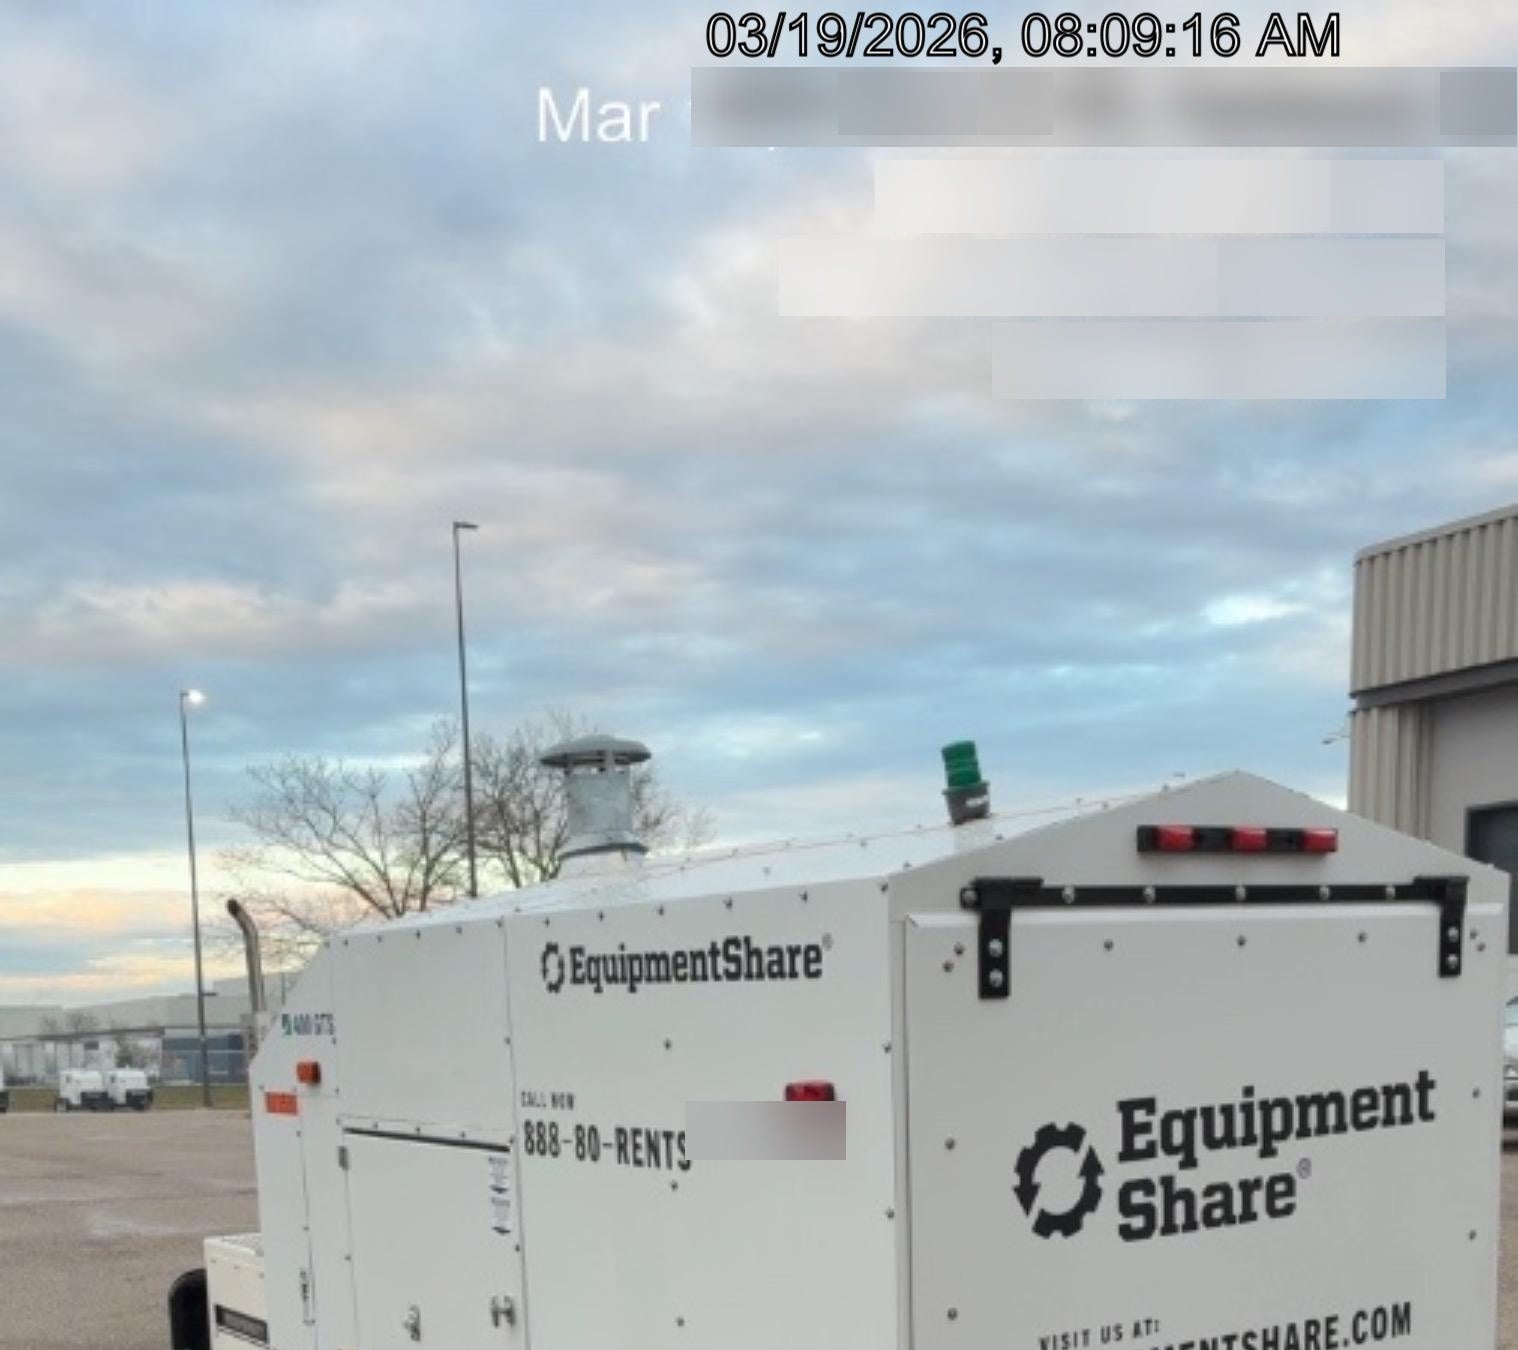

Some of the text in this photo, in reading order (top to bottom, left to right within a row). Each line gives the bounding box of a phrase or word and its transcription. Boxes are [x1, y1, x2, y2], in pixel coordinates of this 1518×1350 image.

[521, 1091, 547, 1108] CALL
[1117, 1070, 1437, 1170] Equipment
[1117, 1171, 1297, 1243] Share
[1100, 1323, 1123, 1345] US
[1132, 1318, 1160, 1339] AT:
